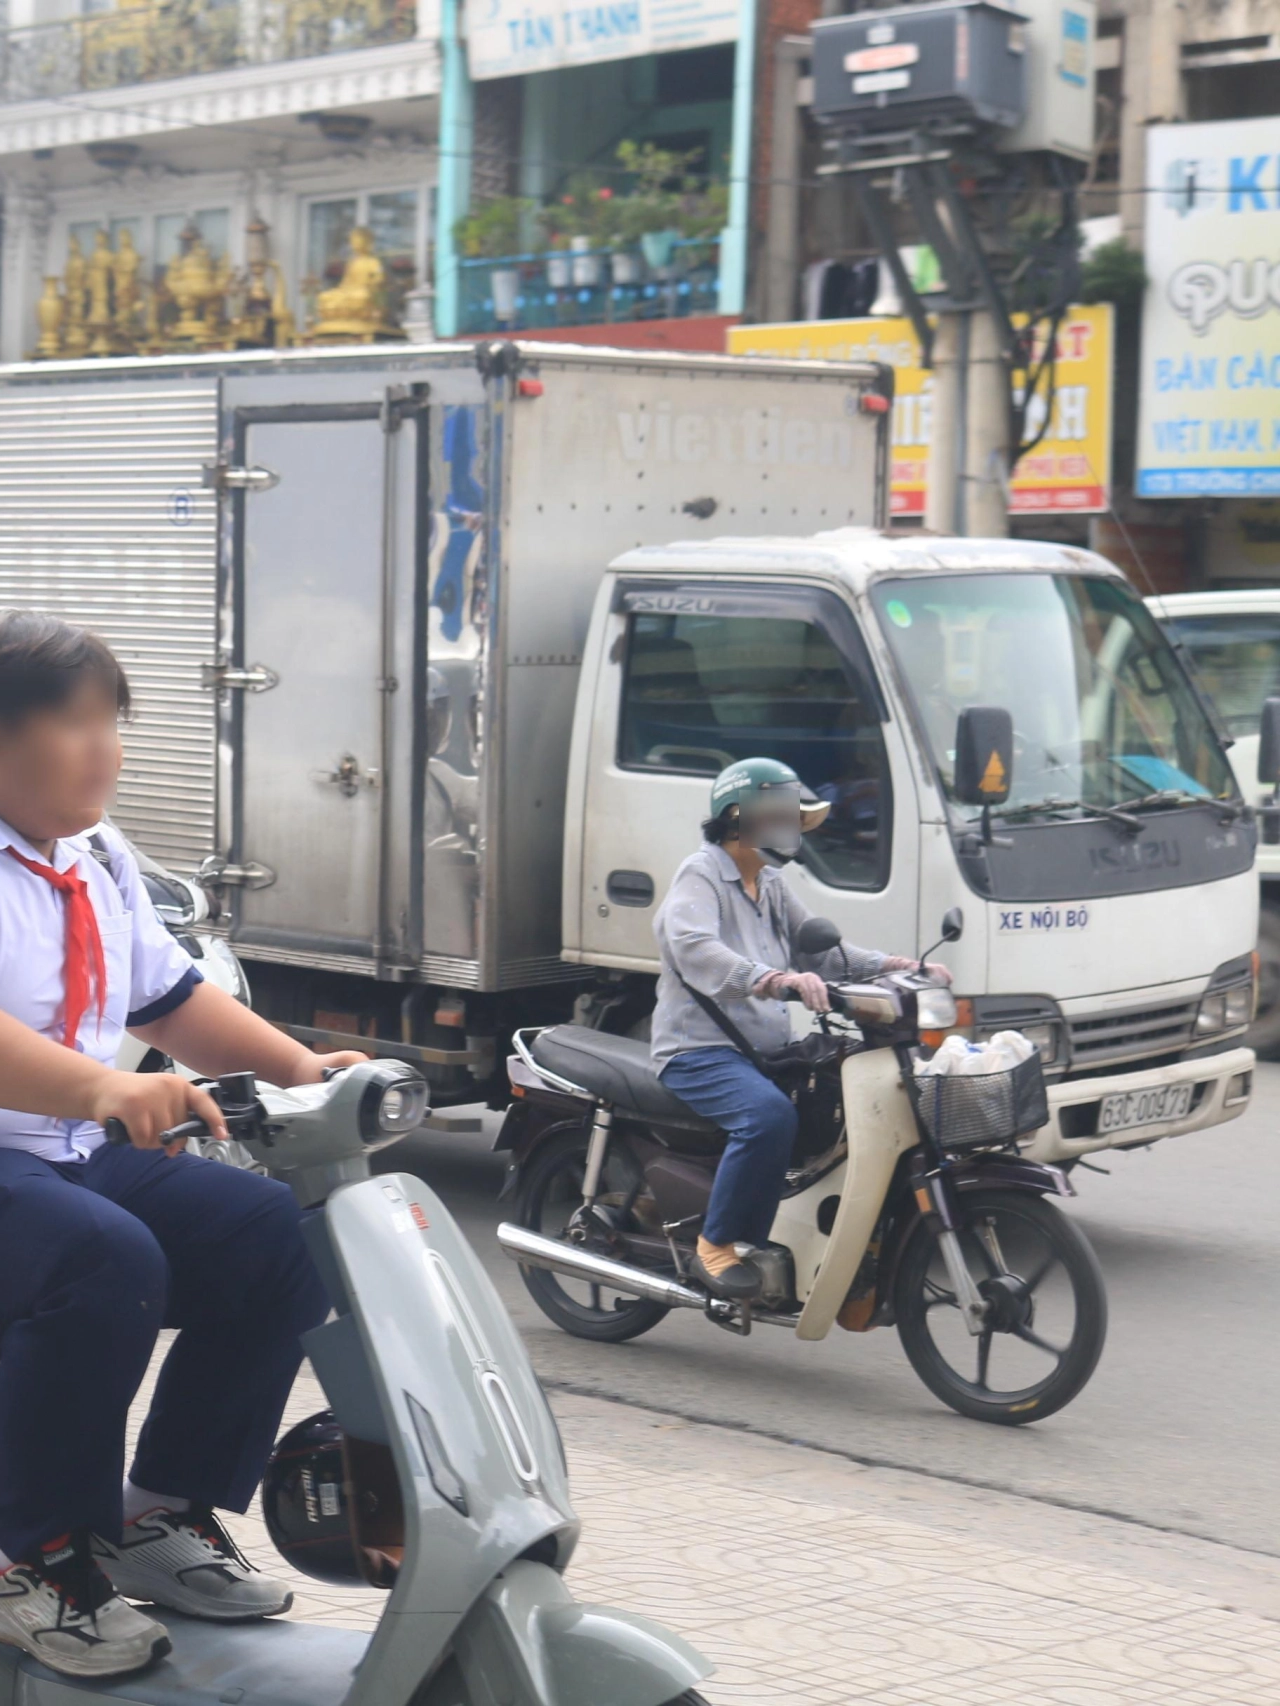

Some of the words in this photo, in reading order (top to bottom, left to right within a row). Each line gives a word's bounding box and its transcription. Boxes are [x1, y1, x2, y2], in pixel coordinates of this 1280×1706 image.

[1228, 154, 1280, 213] K
[1000, 911, 1024, 930] XE
[1030, 905, 1060, 932] NỘI
[1065, 904, 1088, 931] BỘ
